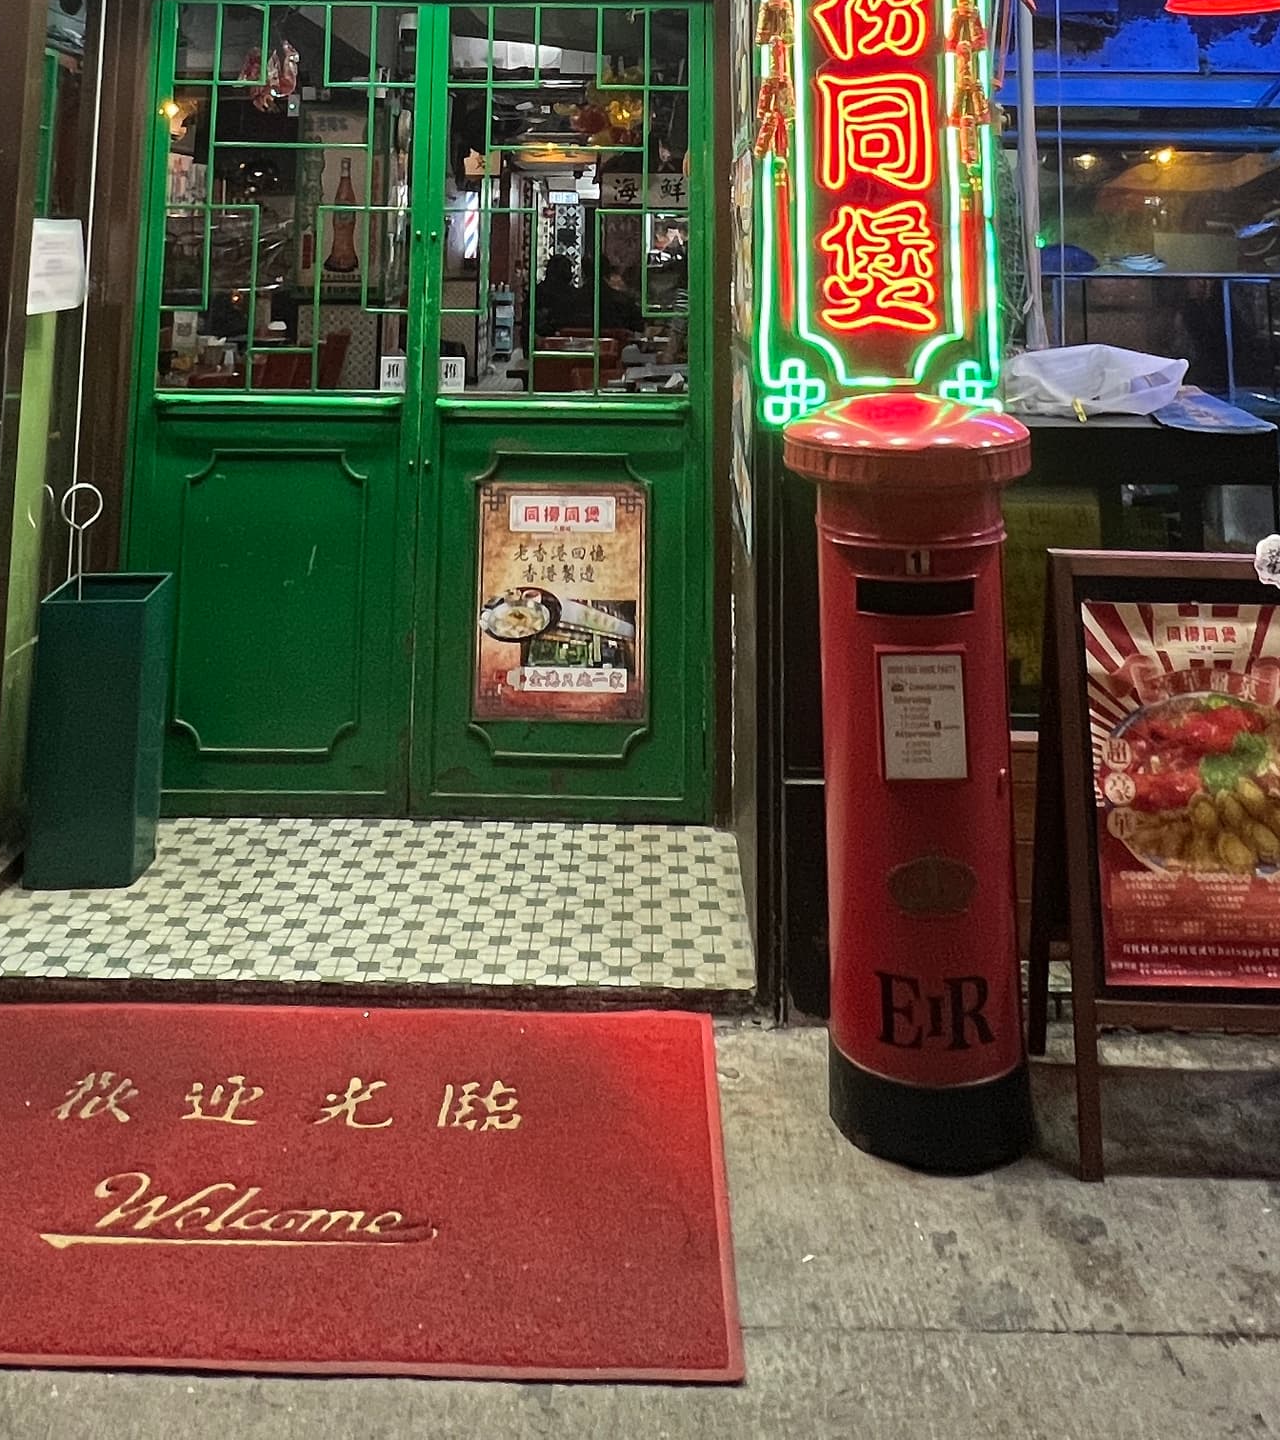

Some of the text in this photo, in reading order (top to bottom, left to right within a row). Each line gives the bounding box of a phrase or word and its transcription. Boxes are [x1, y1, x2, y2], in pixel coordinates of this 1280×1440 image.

[614, 177, 686, 203] 海鮮
[55, 1070, 523, 1131] 歡迎光臨
[96, 1171, 402, 1240] Welcome
